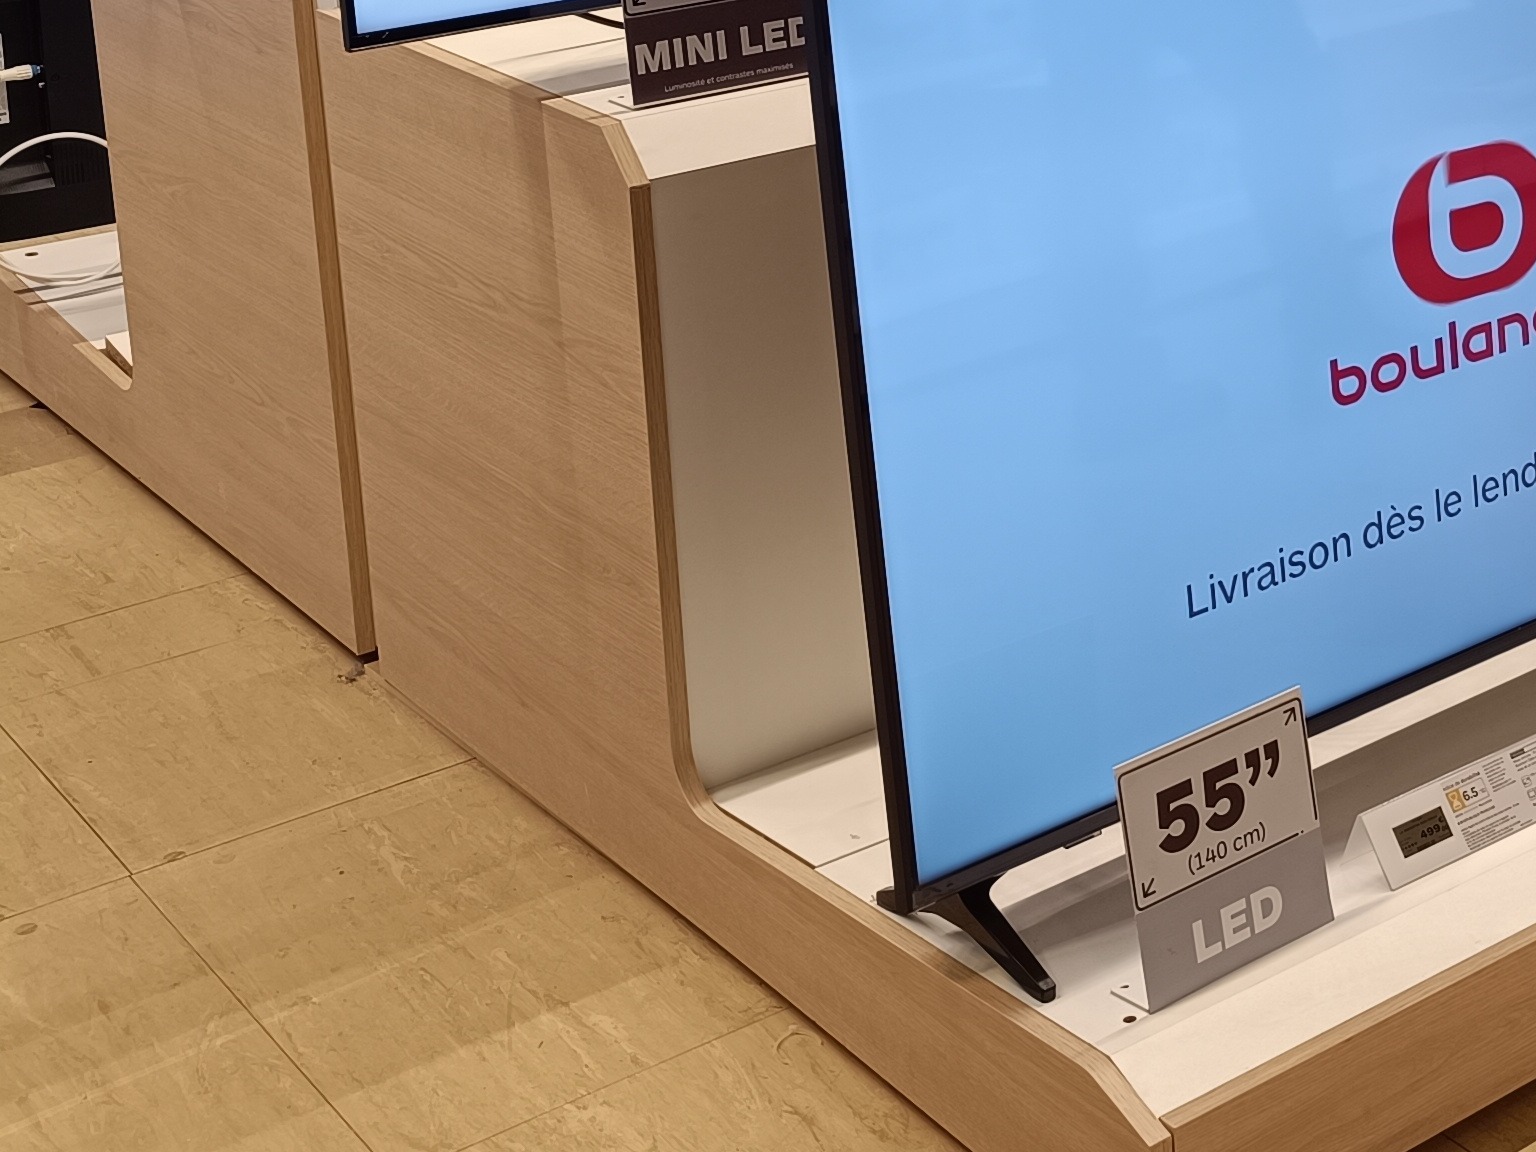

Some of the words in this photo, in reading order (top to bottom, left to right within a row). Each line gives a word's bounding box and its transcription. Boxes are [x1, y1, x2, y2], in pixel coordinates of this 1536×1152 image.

[634, 29, 728, 76] MINI
[739, 16, 806, 56] LED
[664, 77, 705, 93] Luminosité
[706, 77, 715, 85] et
[716, 69, 755, 83] contrastes
[756, 61, 794, 75] maximisés
[1186, 531, 1353, 619] Livraison
[1362, 504, 1426, 550] dès
[1435, 488, 1462, 522] le
[1462, 786, 1479, 801] 6.5
[1187, 841, 1228, 876] (140
[1233, 821, 1266, 851] cm)
[1191, 885, 1283, 964] LED
